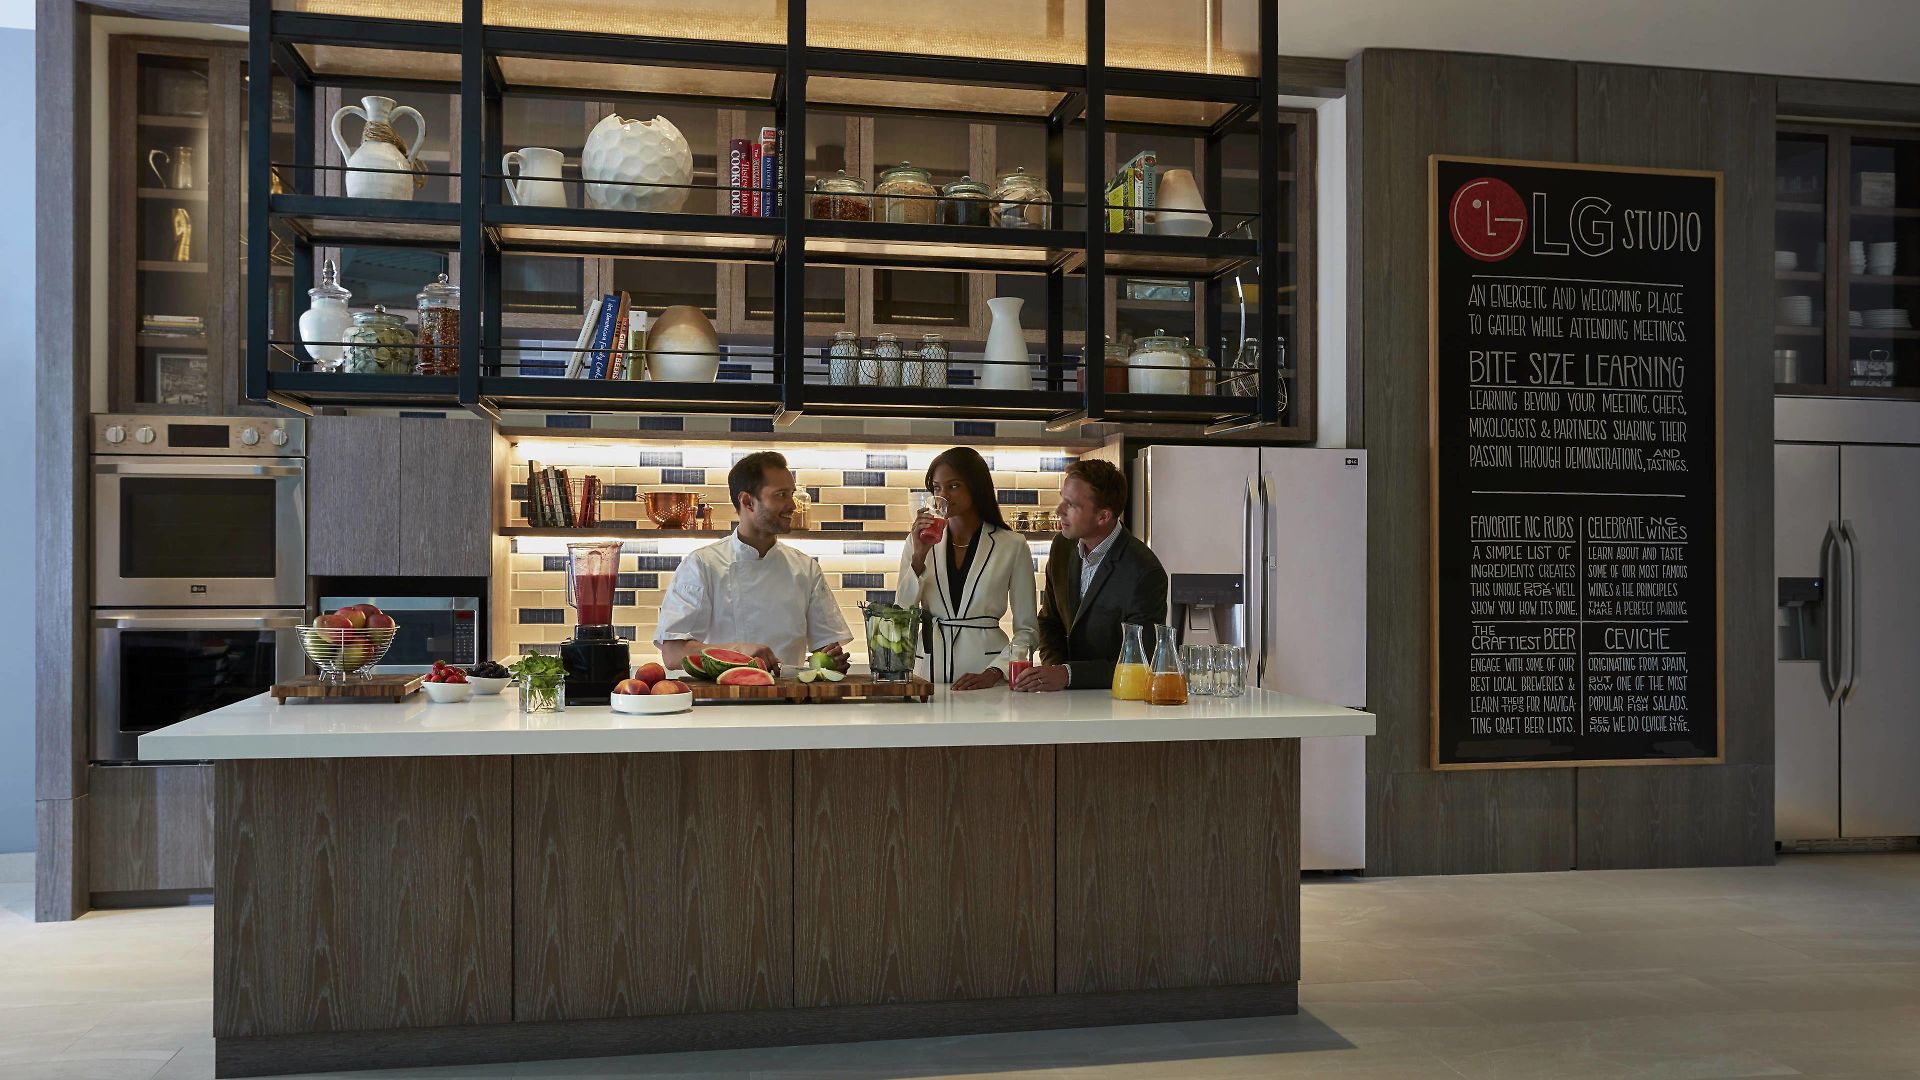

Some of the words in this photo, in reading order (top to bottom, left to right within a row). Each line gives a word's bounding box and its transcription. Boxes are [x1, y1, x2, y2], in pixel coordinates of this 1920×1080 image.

[1533, 192, 1613, 257] LG
[1623, 209, 1700, 252] STUDIO
[1468, 285, 1485, 307] AN
[1491, 285, 1547, 309] ENERGETIC
[1553, 287, 1575, 310] AND
[1581, 288, 1641, 312] WELCOMING
[1648, 291, 1683, 313] PLACE
[1468, 314, 1481, 334] TO
[1488, 315, 1526, 336] GATHER
[1531, 316, 1563, 337] WHILE
[1570, 318, 1628, 340] ATTENDING
[1634, 320, 1686, 342] MEETINGS.
[612, 358, 622, 380] BEERS
[1470, 351, 1516, 383] BITE
[1529, 353, 1574, 385] SIZE
[1586, 354, 1684, 388] LEARNING
[1470, 390, 1517, 410] LEARNING
[1524, 392, 1560, 411] BEYOND
[1568, 393, 1595, 412] YOUR
[1603, 394, 1649, 413] MEETING.
[1653, 395, 1687, 415] CHEFS,
[1470, 418, 1536, 438] MIXOLOGISTS
[1541, 420, 1551, 438] &
[1554, 419, 1606, 440] PARTNERS
[1613, 420, 1656, 441] SHARING
[1660, 421, 1686, 442] THEIR
[1470, 445, 1512, 467] PASSION
[1517, 446, 1560, 468] THROUGH
[1566, 447, 1645, 472] DEMONSTRATIONS,
[1653, 449, 1680, 458] AND
[1647, 459, 1688, 471] TASTINGS.
[1471, 516, 1521, 538] FAVORITE
[1525, 516, 1540, 538] NC
[1544, 516, 1573, 538] RUBS
[1588, 517, 1644, 539] CELEBRATE
[1651, 517, 1677, 525] NC
[1646, 526, 1687, 539] WINES
[1473, 546, 1480, 559] A
[1486, 546, 1522, 559] SIMPLE
[1528, 546, 1551, 559] LIST
[1558, 546, 1571, 559] OF
[1589, 547, 1613, 560] LEARN
[1616, 547, 1639, 560] ABOUT
[1642, 547, 1656, 560] AND
[1660, 547, 1683, 560] TASTE
[1471, 564, 1534, 578] INGREDIENTS
[1539, 564, 1575, 578] CREATES
[1588, 565, 1607, 578] SOME
[1611, 565, 1619, 578] OF
[1622, 565, 1635, 578] OUR
[1639, 565, 1659, 578] MOST
[1663, 565, 1687, 578] FAMOUS
[1470, 583, 1490, 596] THIS
[1493, 583, 1521, 596] UNIQUE
[1524, 589, 1552, 597] RUB
[1588, 583, 1613, 596] WINES
[1622, 583, 1634, 596] THE
[1637, 583, 1678, 597] PRINCIPLES
[1471, 601, 1495, 614] SHOW
[1498, 601, 1514, 615] YOU
[1519, 601, 1537, 615] HOW
[1556, 602, 1577, 615] DONE.
[1616, 601, 1621, 615] A
[1624, 601, 1653, 615] PERFECT
[1473, 626, 1495, 635] THE
[1472, 636, 1541, 650] CRAFTIEST
[1544, 628, 1575, 650] BEER
[1605, 628, 1670, 649] CEVICHE
[1471, 658, 1501, 672] ENGAGE
[1505, 658, 1523, 672] WITH
[1526, 658, 1544, 671] SOME
[1547, 657, 1555, 671] OF
[1559, 657, 1574, 671] OUR
[1588, 657, 1636, 671] ORIGINATING
[1639, 657, 1658, 671] FROM
[1662, 657, 1688, 673] SPAIN,
[1471, 677, 1490, 691] BEST
[1494, 676, 1517, 691] LOCAL
[1522, 676, 1563, 691] BREWERIES
[1569, 678, 1575, 690] &
[1617, 676, 1631, 691] ONE
[1635, 676, 1645, 690] OF
[1648, 676, 1664, 690] THE
[1668, 676, 1687, 691] MOST
[1471, 696, 1499, 712] LEARN
[1527, 696, 1540, 712] FOR
[1589, 696, 1623, 711] POPULAR
[1653, 696, 1688, 711] SALADS.
[1471, 717, 1491, 734] TING
[1496, 717, 1520, 733] CRAFT
[1524, 717, 1544, 733] BEER
[1548, 717, 1575, 733] LISTS.
[1613, 716, 1625, 732] WE
[1628, 716, 1639, 732] DO
[1642, 716, 1667, 732] CEVICHE
[1669, 722, 1690, 732] STYLE.
